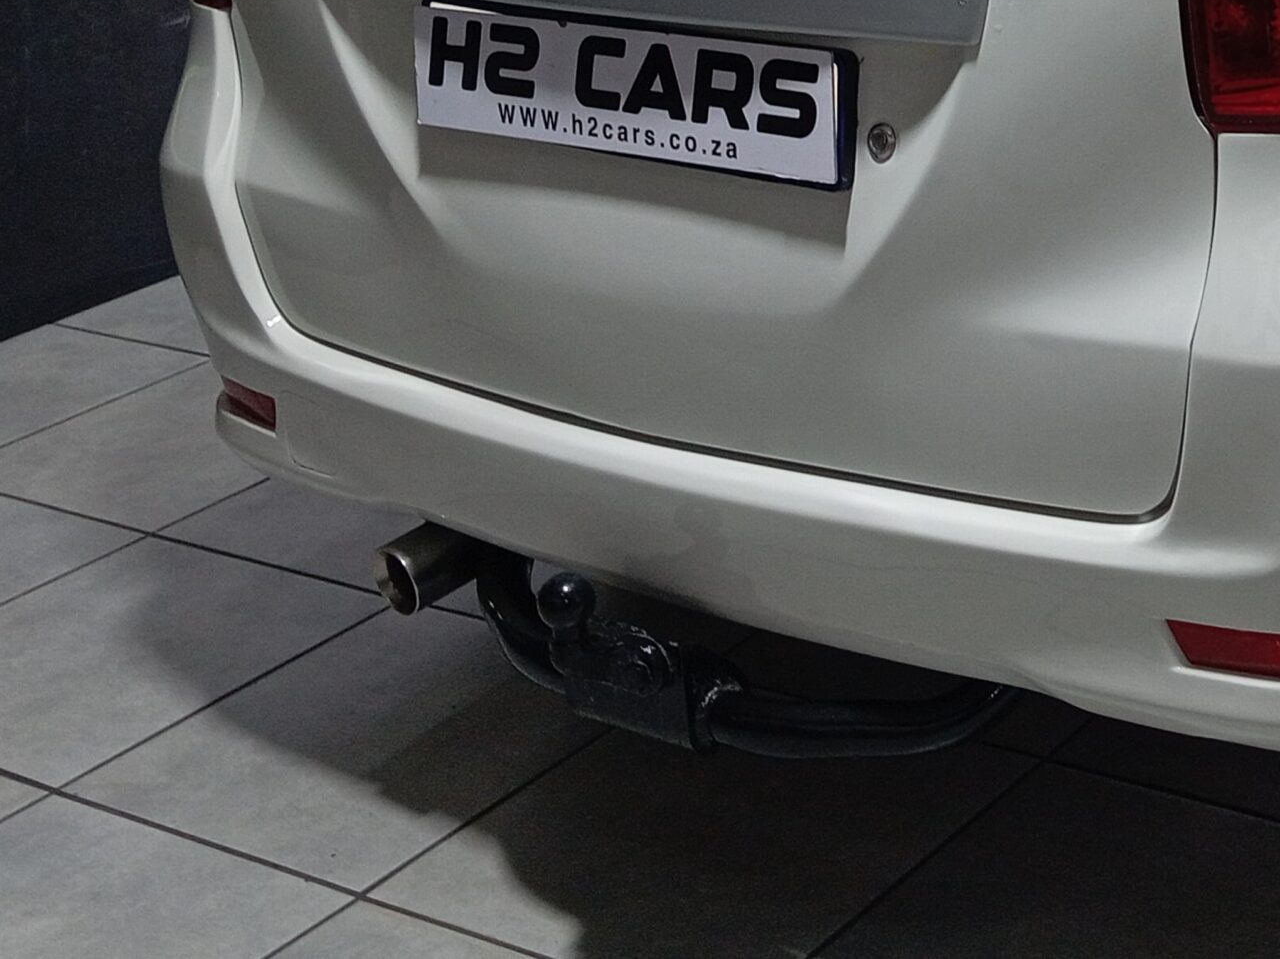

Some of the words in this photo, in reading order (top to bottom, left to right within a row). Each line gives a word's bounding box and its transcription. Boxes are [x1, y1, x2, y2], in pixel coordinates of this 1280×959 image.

[428, 15, 541, 100] H2
[575, 35, 820, 139] CARS
[498, 102, 739, 160] www.h2cars.co.za
